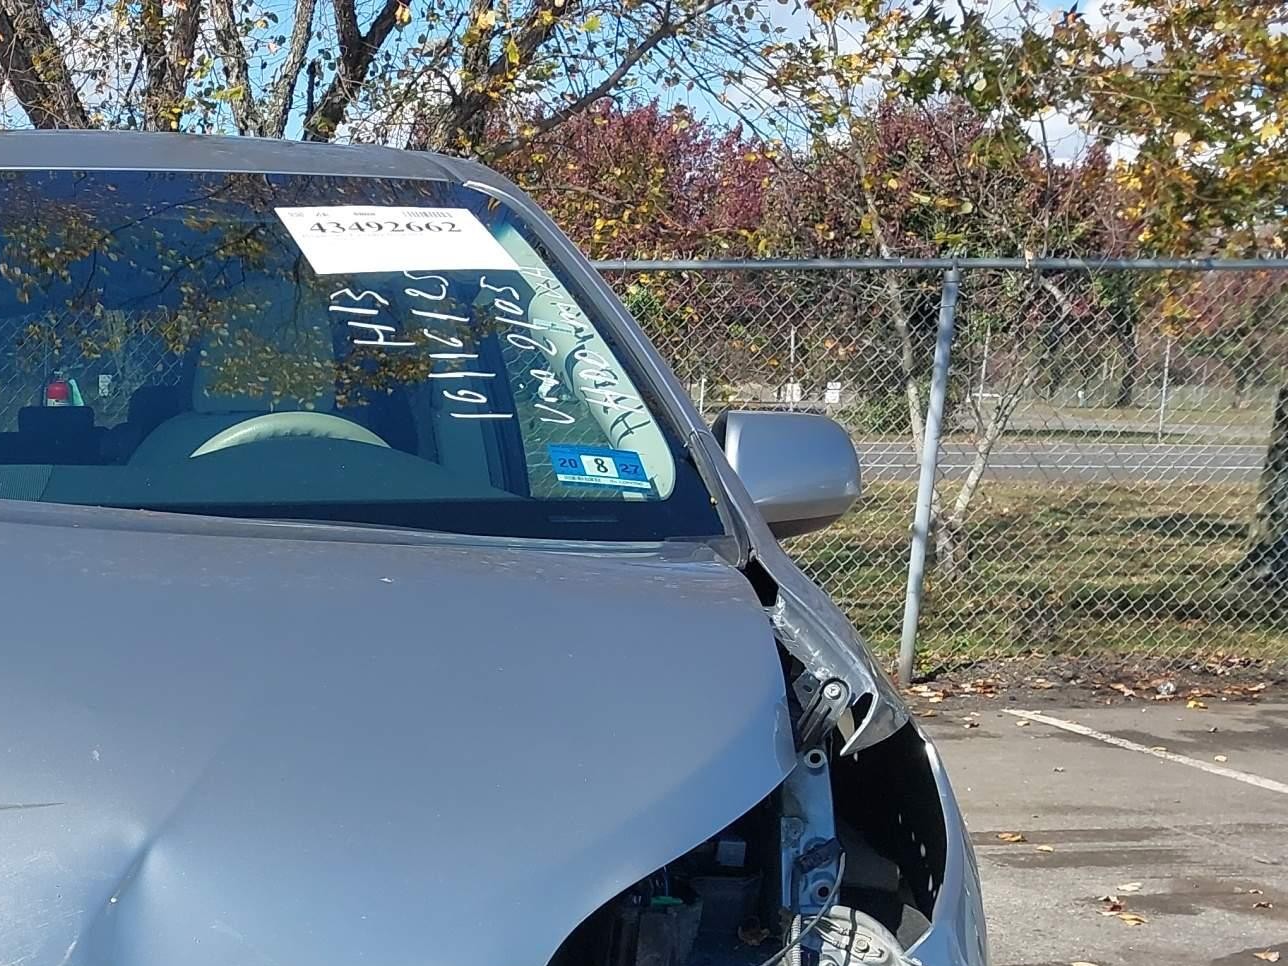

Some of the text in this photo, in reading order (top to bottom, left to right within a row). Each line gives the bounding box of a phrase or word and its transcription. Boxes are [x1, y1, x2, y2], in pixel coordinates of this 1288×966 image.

[310, 220, 462, 233] 43492662
[558, 457, 640, 474] 20 8 27
